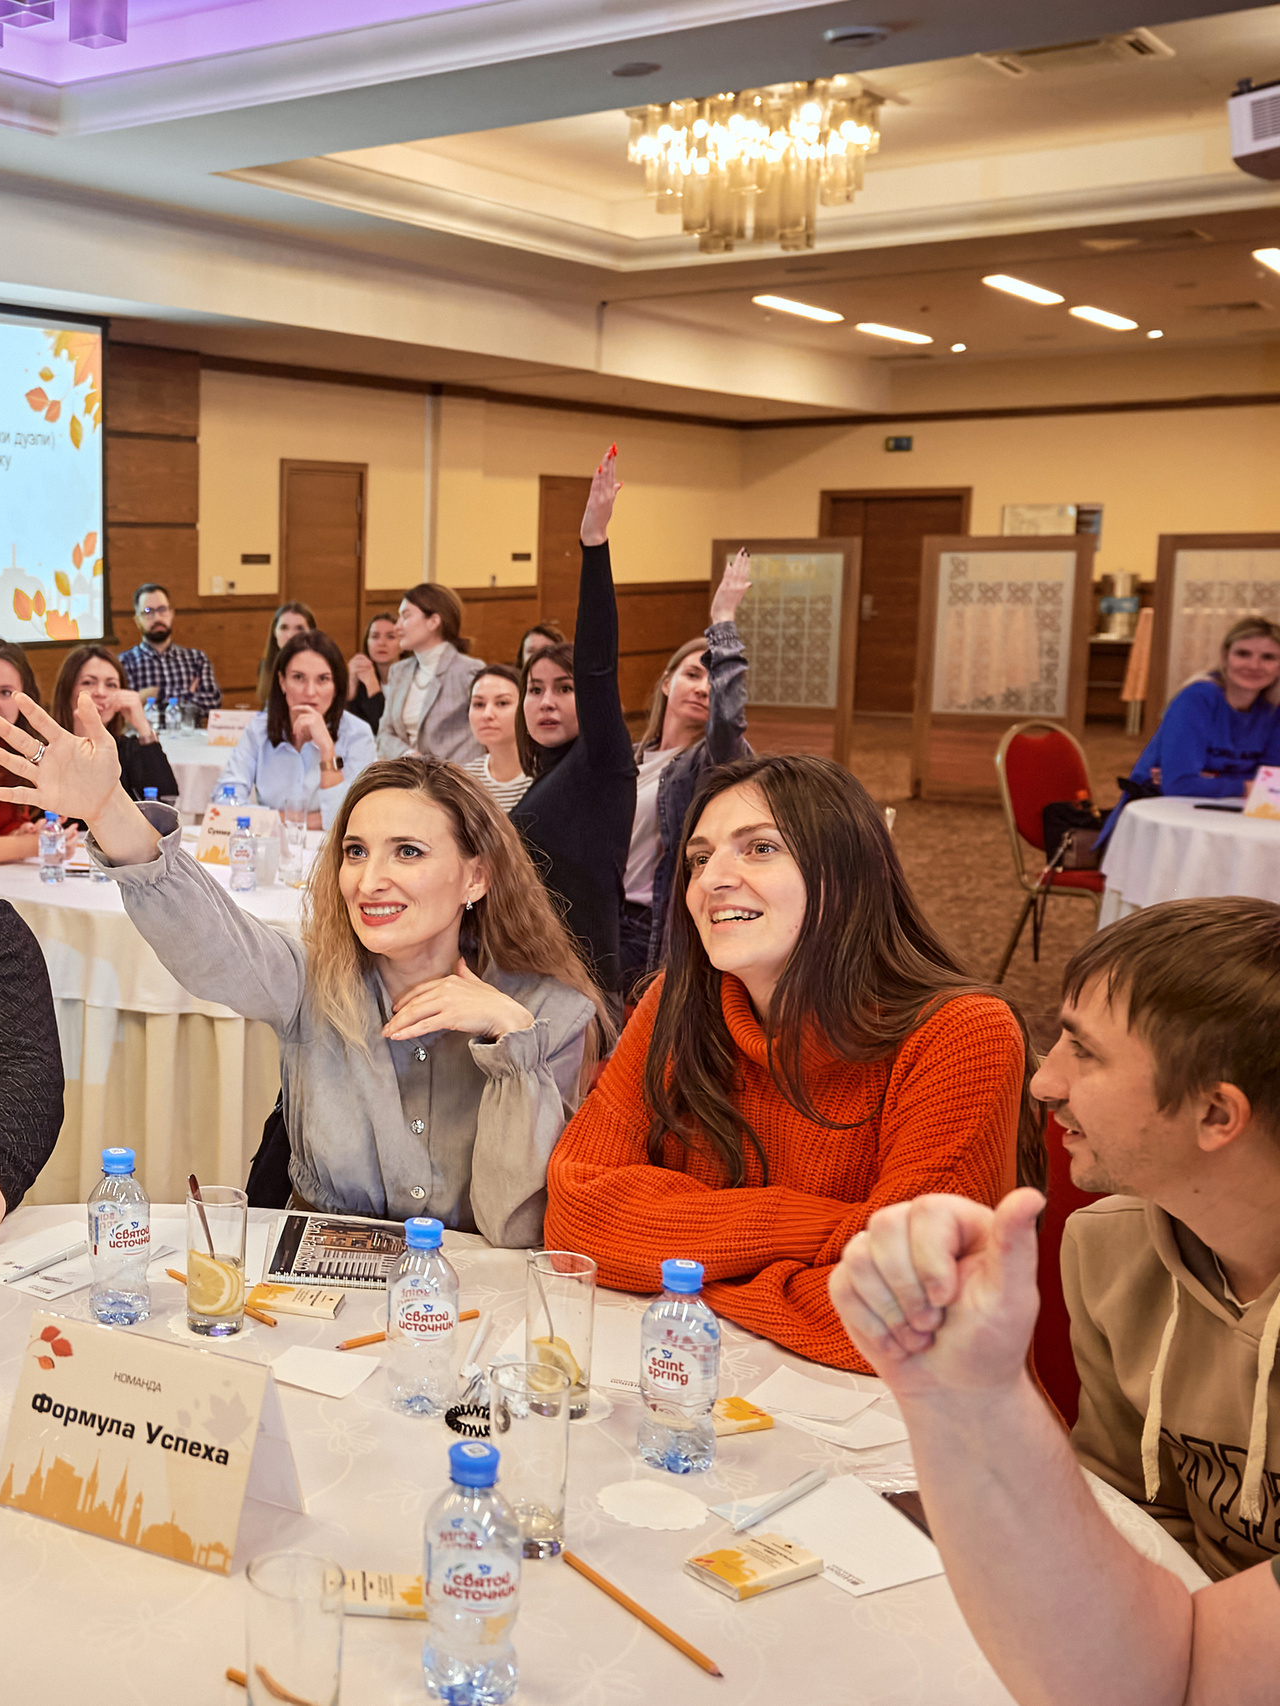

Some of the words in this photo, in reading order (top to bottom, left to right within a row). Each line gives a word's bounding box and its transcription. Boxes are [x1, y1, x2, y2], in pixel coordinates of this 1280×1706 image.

[648, 1365, 689, 1386] spring
[651, 1357, 685, 1373] saint
[31, 1392, 136, 1439] Формула
[145, 1421, 230, 1466] Успеха
